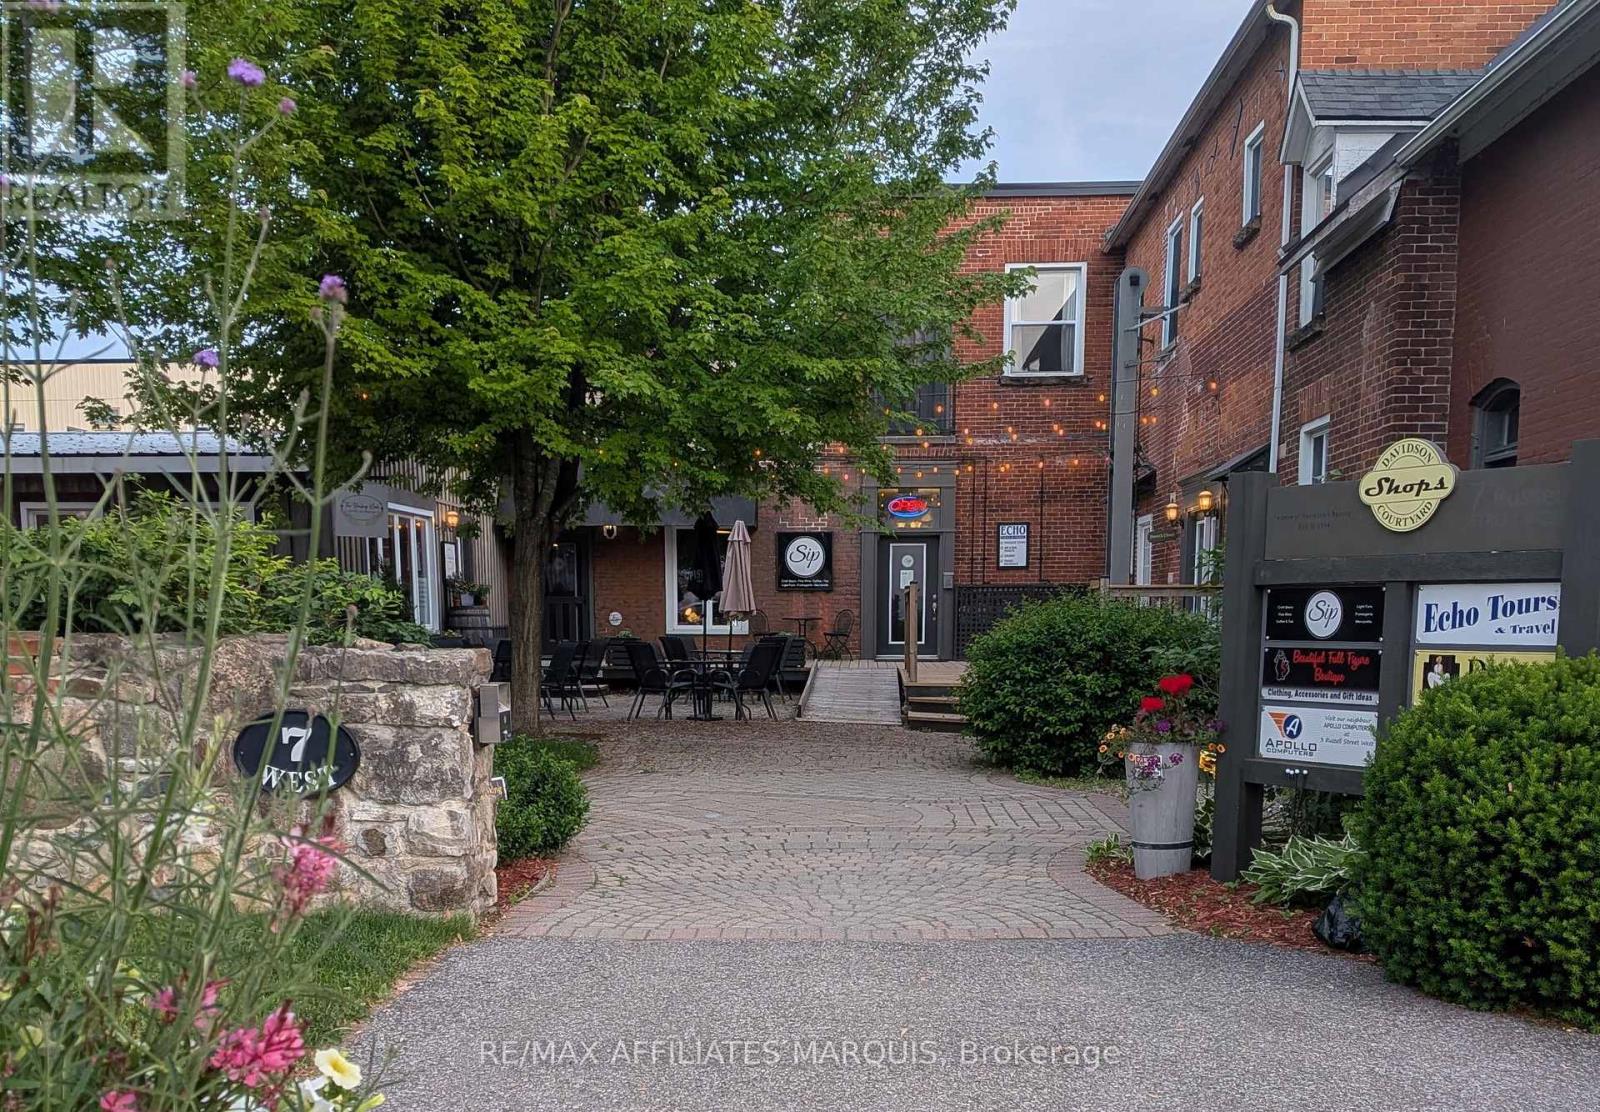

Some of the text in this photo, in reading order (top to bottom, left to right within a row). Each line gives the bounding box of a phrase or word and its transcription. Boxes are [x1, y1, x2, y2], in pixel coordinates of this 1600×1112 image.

[1382, 443, 1434, 468] DAVIDSON
[1364, 476, 1449, 497] Shops
[1377, 501, 1433, 527] COURTYARD
[1001, 525, 1026, 536] ECHO
[789, 544, 821, 569] Sip
[1308, 599, 1339, 629] Sip
[1423, 594, 1558, 633] Echo Tours
[1509, 619, 1556, 634] Travel
[1328, 651, 1345, 664] Full
[1267, 688, 1373, 701] Clothing, Accessories and Gift Ideas
[281, 727, 312, 762] 7
[1265, 738, 1317, 752] APOLLO
[1266, 748, 1314, 757] COMPUTERS
